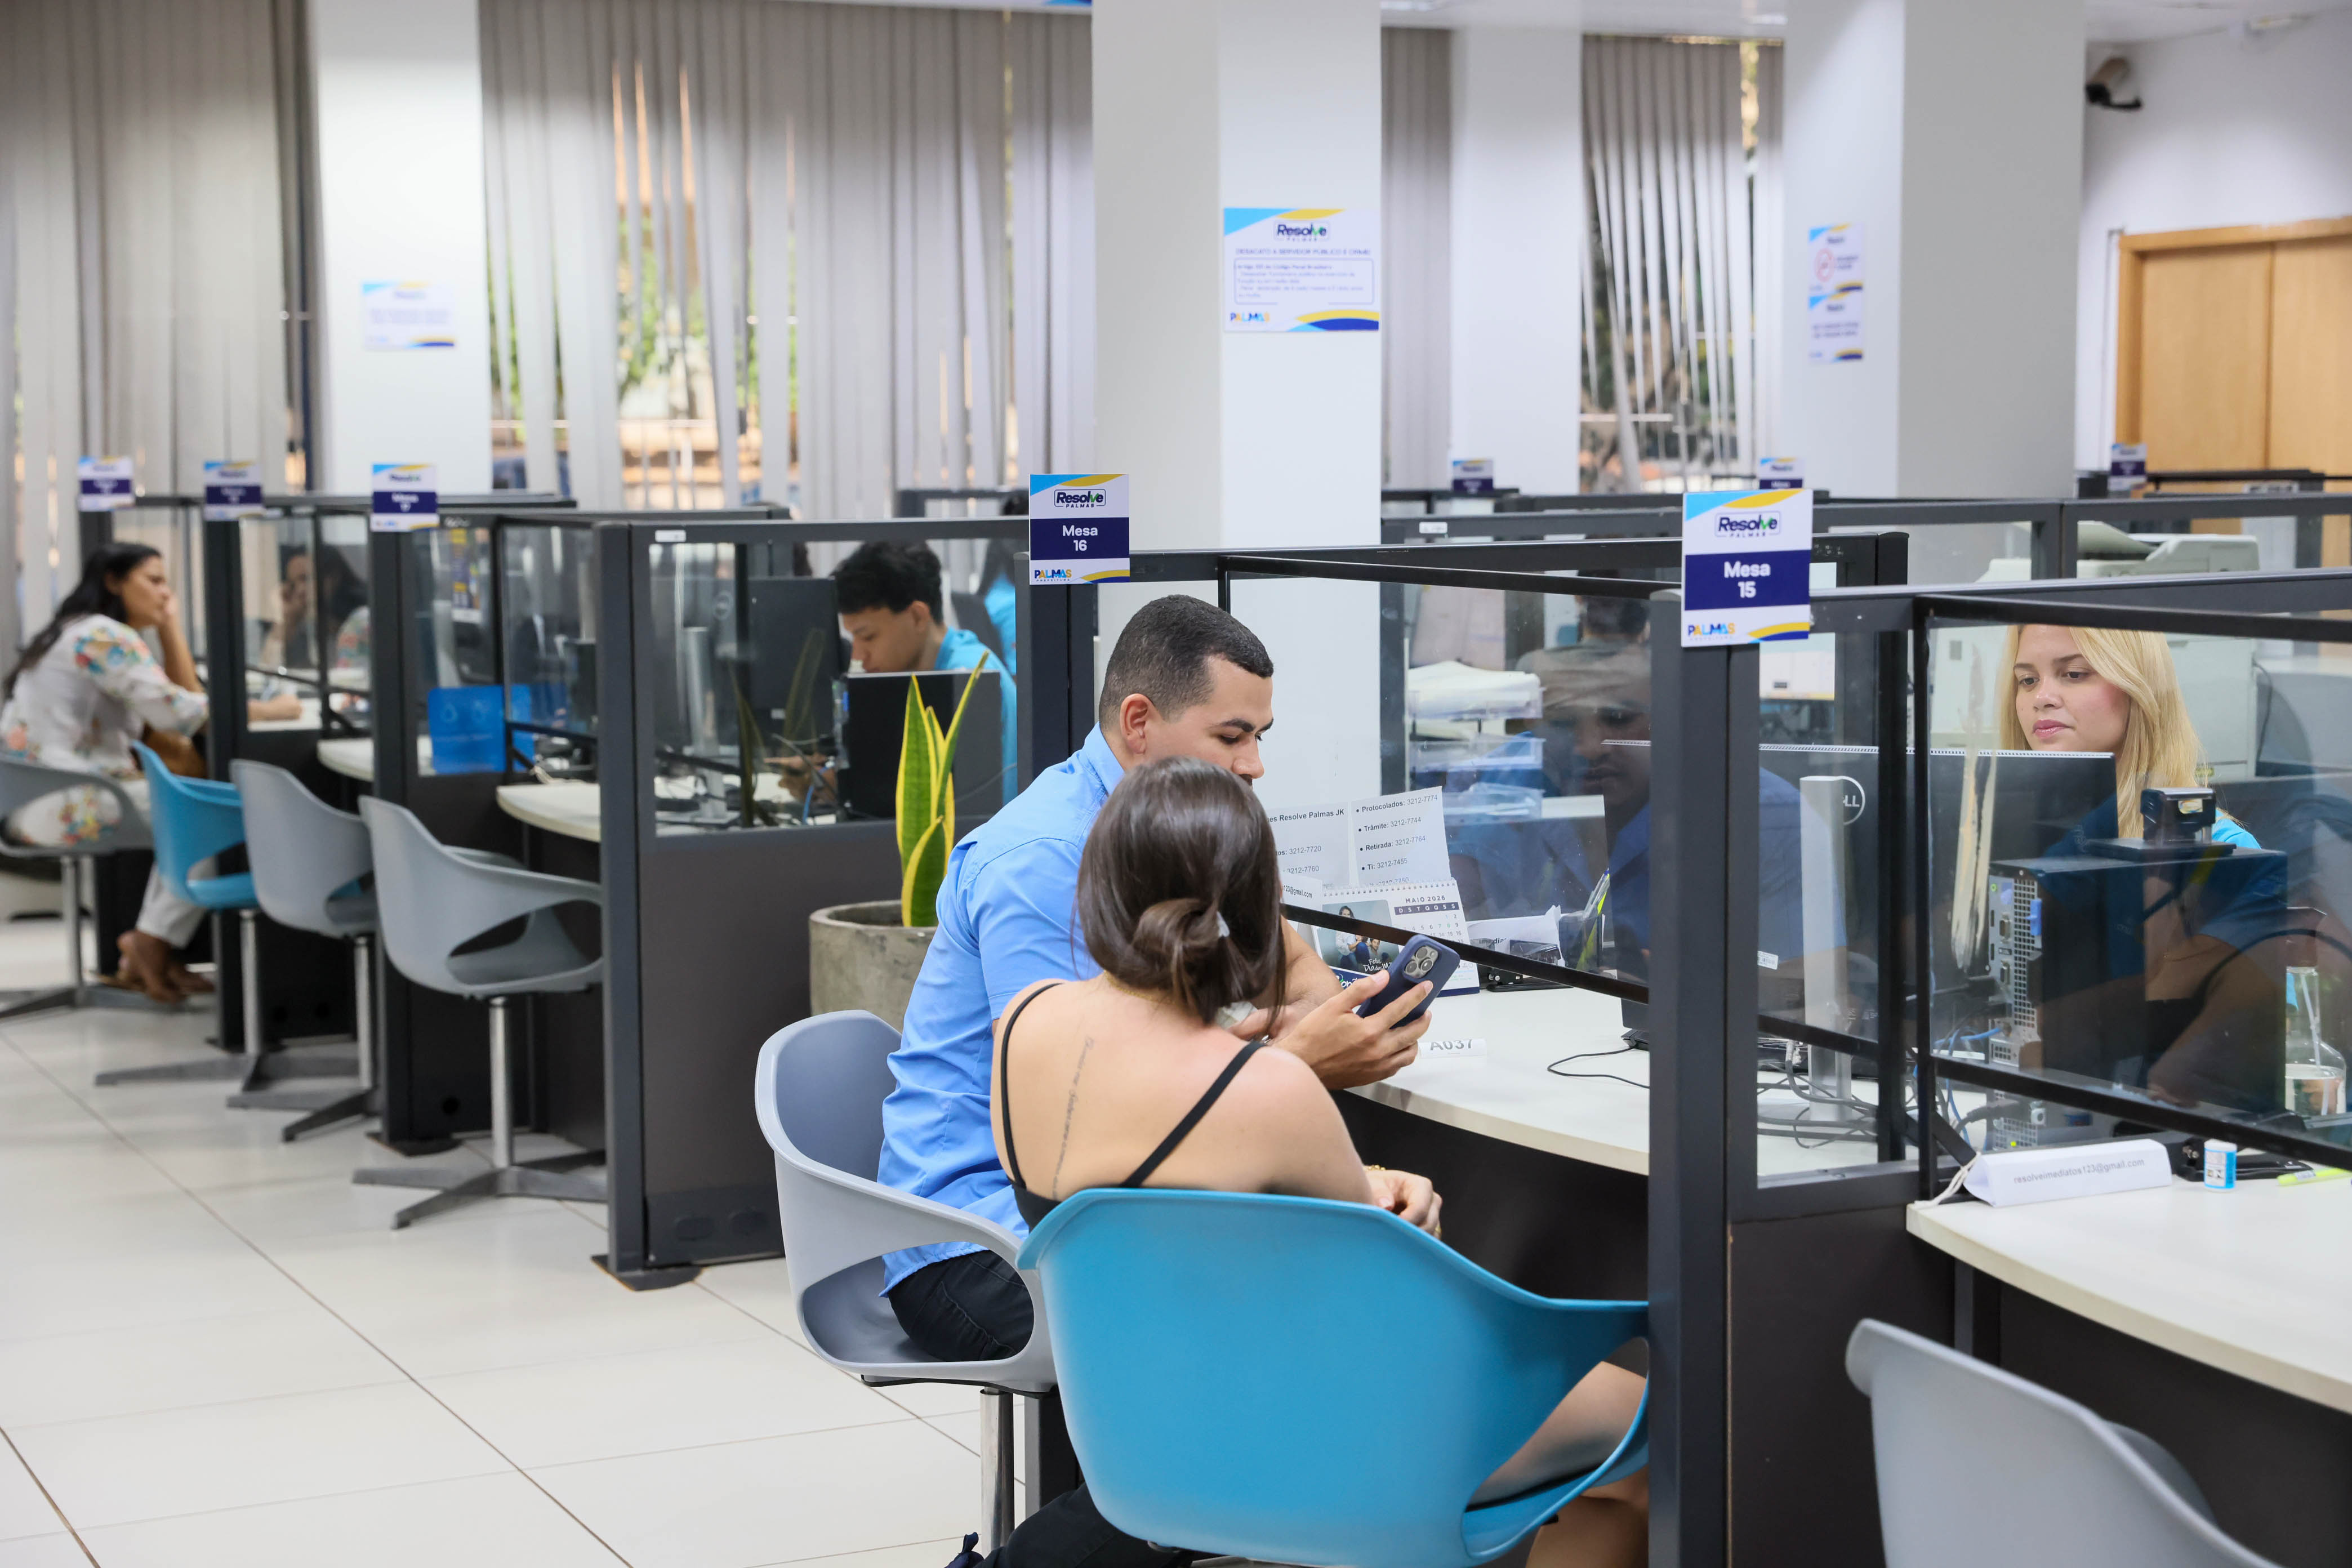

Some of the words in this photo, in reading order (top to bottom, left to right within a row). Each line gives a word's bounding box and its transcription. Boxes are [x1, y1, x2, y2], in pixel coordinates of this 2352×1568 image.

[1277, 224, 1326, 236] Resolve
[1230, 313, 1269, 322] PALMAS
[1057, 491, 1103, 504] Resolve
[1718, 515, 1778, 531] Resolve
[1063, 525, 1098, 536] Mesa
[1073, 540, 1087, 551] 16
[1035, 569, 1072, 578] PALMAS
[1724, 561, 1771, 578] Mesa
[1738, 581, 1756, 598] 15
[1688, 623, 1735, 635] PALMAS
[1362, 801, 1405, 812] Protocolados:
[1407, 795, 1437, 805] 3212-7774
[1364, 822, 1389, 832] Trâmite:
[1391, 817, 1421, 827] 3212-7744
[1365, 841, 1393, 850] Retirada:
[1395, 835, 1426, 846] 3212-7764
[1289, 845, 1321, 854] 3212-7720
[1377, 858, 1407, 868] 3212-7455
[1431, 1039, 1472, 1050] A037
[2014, 1159, 2145, 1184] resolveimediatos123@gmail.com
